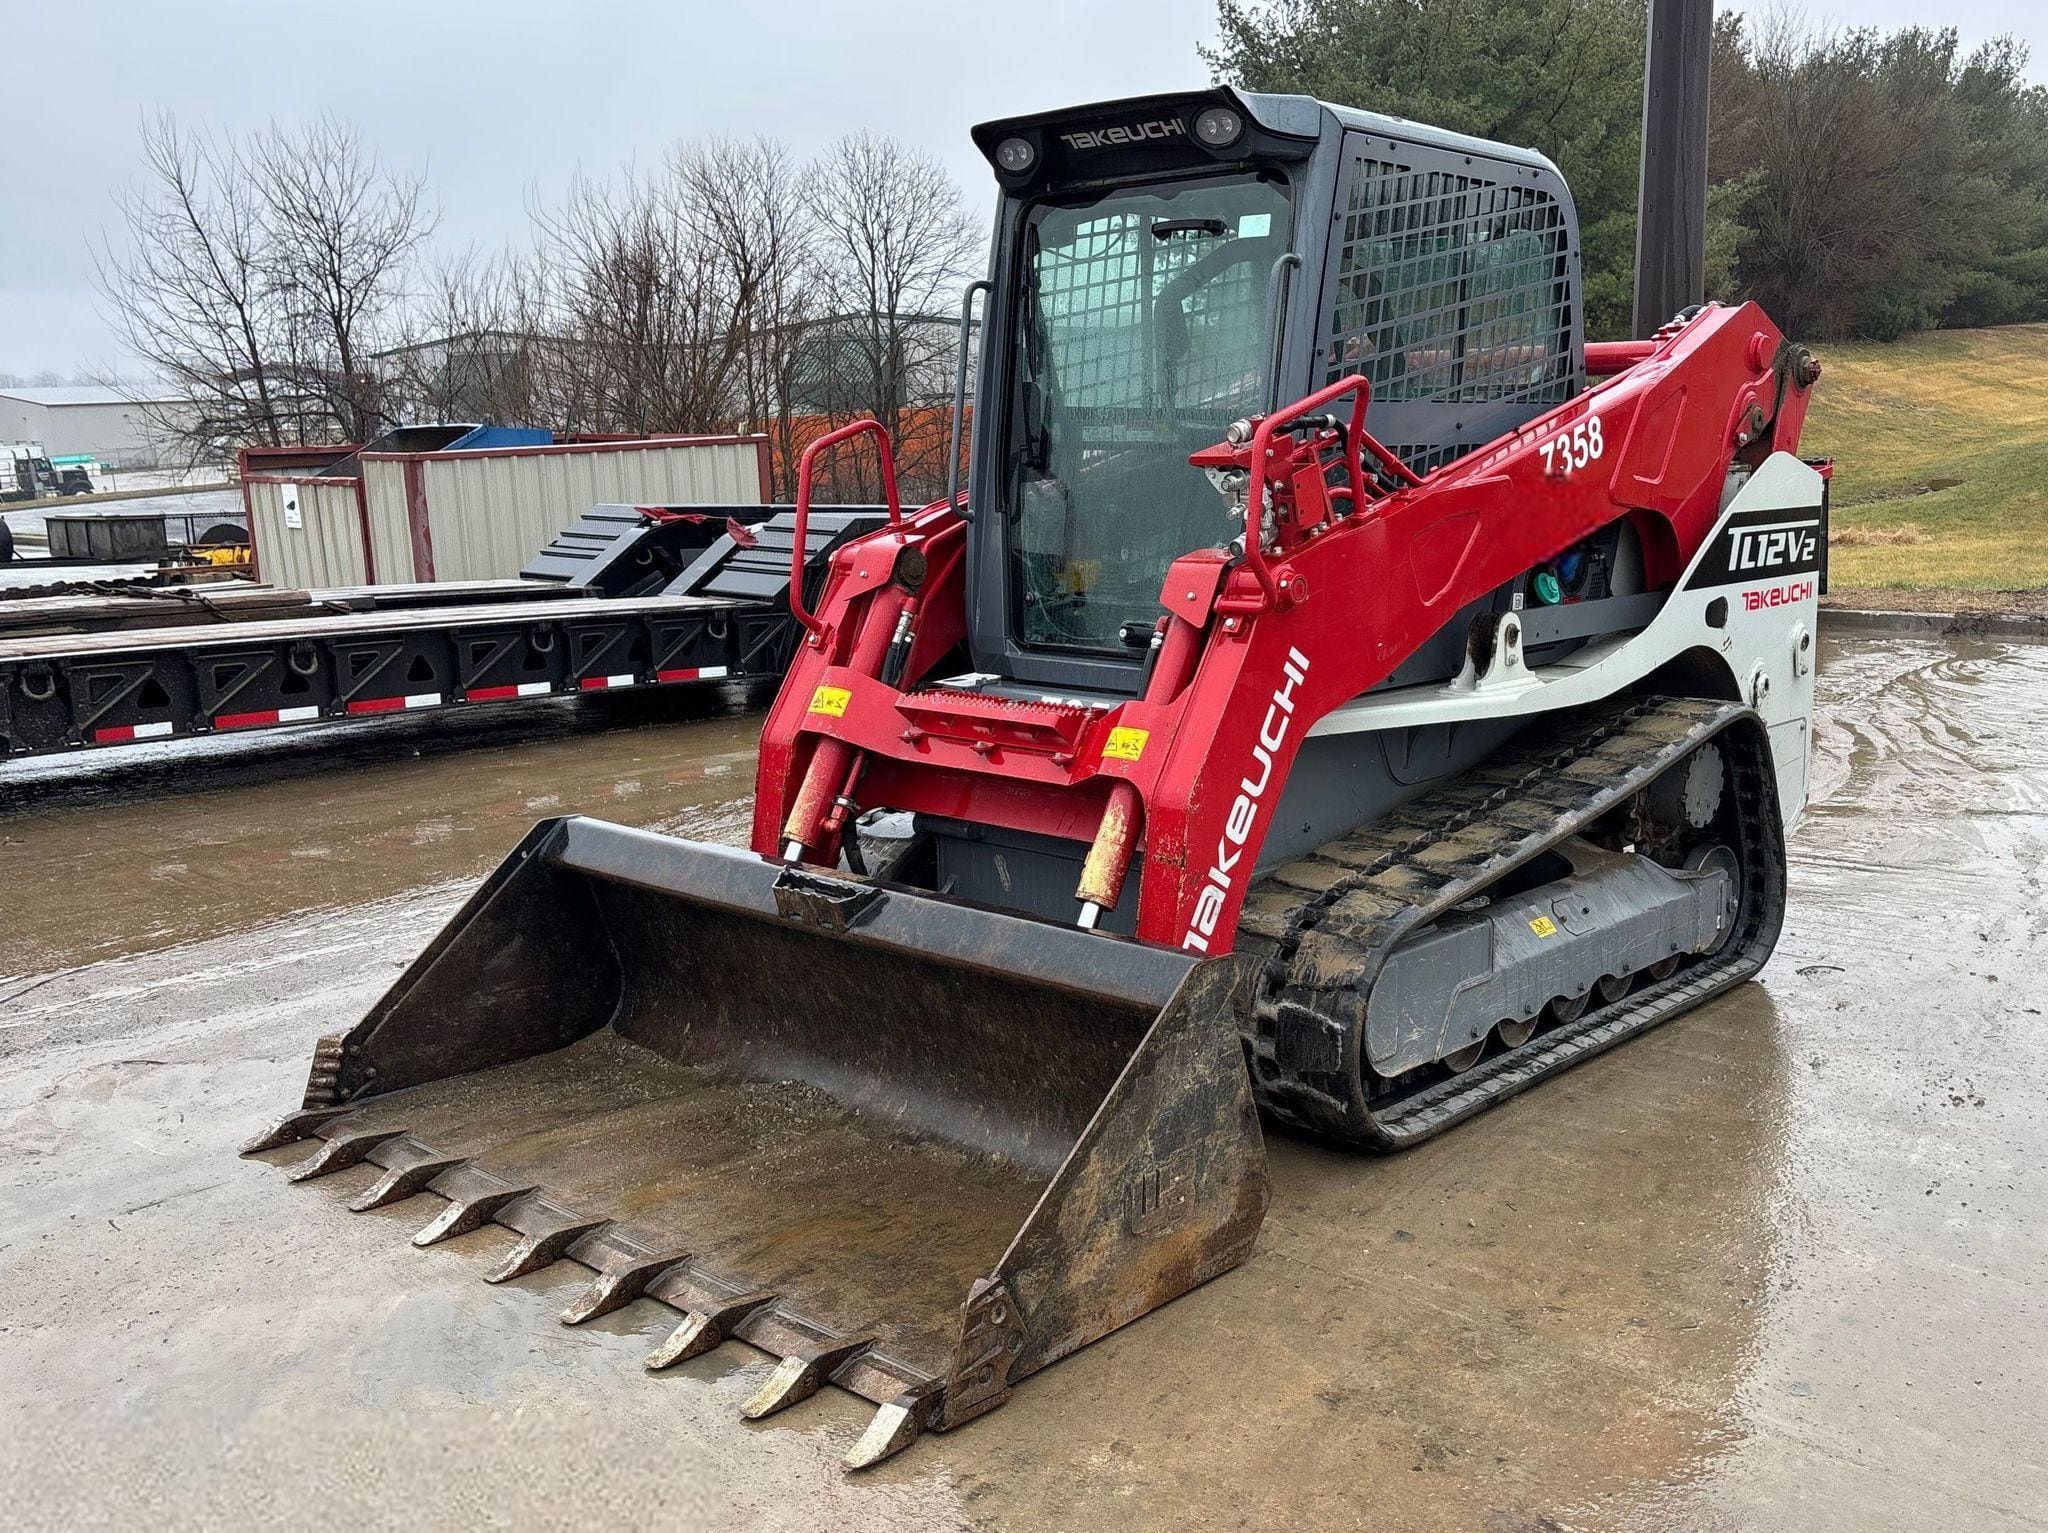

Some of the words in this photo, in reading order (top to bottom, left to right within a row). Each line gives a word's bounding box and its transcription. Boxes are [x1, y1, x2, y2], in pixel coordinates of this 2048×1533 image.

[1060, 118, 1186, 150] TAKEUCHI
[1539, 415, 1603, 475] 7358
[1728, 519, 1819, 571] TL12V2
[1741, 581, 1812, 611] TAKEUCHI
